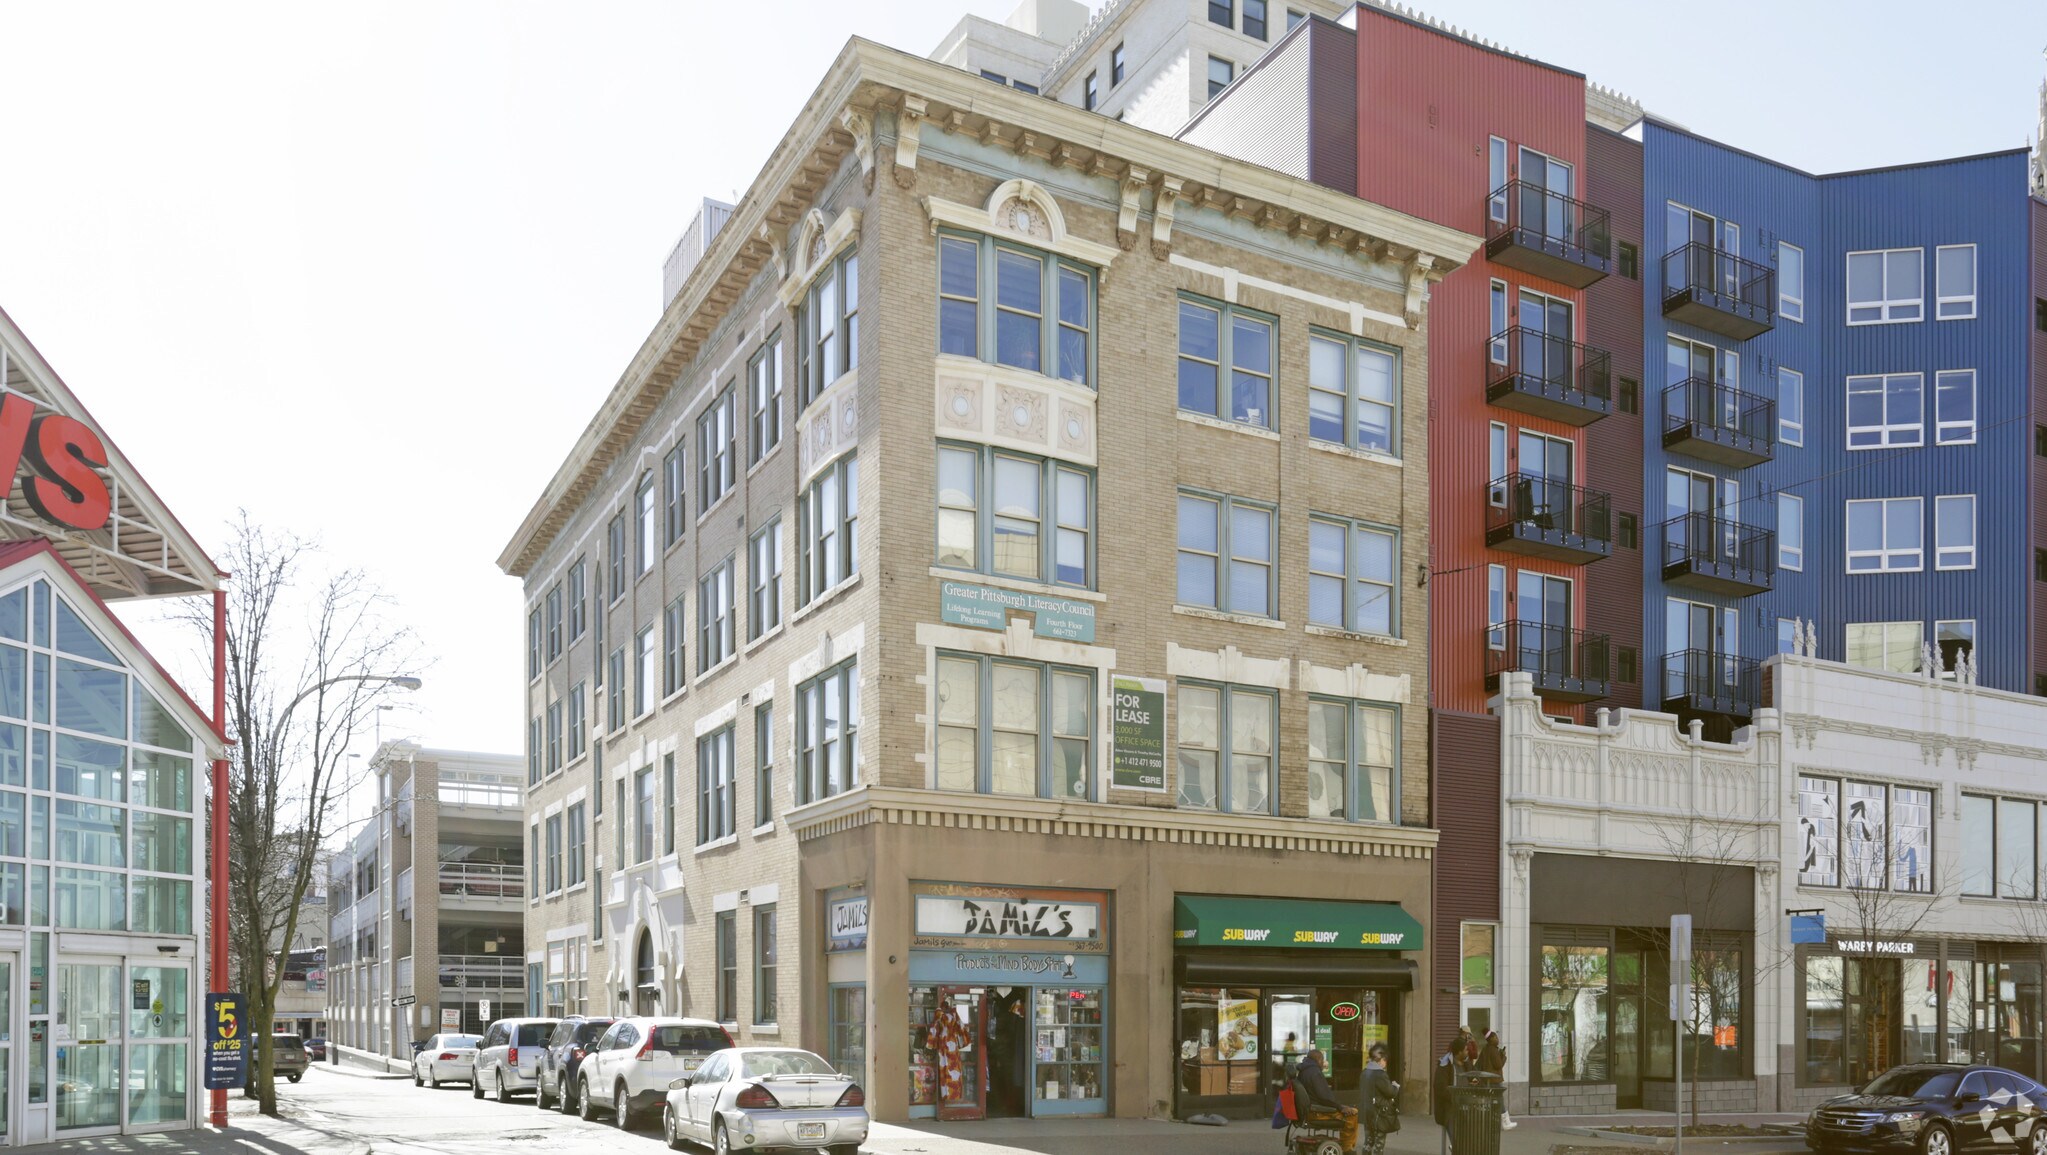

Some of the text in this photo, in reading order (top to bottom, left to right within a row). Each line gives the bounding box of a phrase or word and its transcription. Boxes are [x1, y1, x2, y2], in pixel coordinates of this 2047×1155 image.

[944, 582, 1095, 617] Greater Pittsburgh Literacy Council
[946, 603, 1001, 619] Lifelong Learning
[960, 614, 989, 625] Programs
[1046, 617, 1083, 630] Fourth Floor
[1115, 693, 1140, 709] FOR
[1115, 708, 1150, 725] LEASE
[1115, 736, 1161, 749] OFFICE SPACE
[1129, 757, 1139, 766] 412
[1139, 758, 1148, 767] 471
[1149, 759, 1162, 769] 9500
[1139, 775, 1162, 785] CBRE
[1173, 928, 1404, 945] SUBWAY SUBWAY SUBWAY SUBWAY
[1876, 941, 1914, 954] PARKER
[1334, 1006, 1357, 1017] OPEN
[214, 1002, 238, 1039] $5
[213, 1039, 241, 1050] off $25
